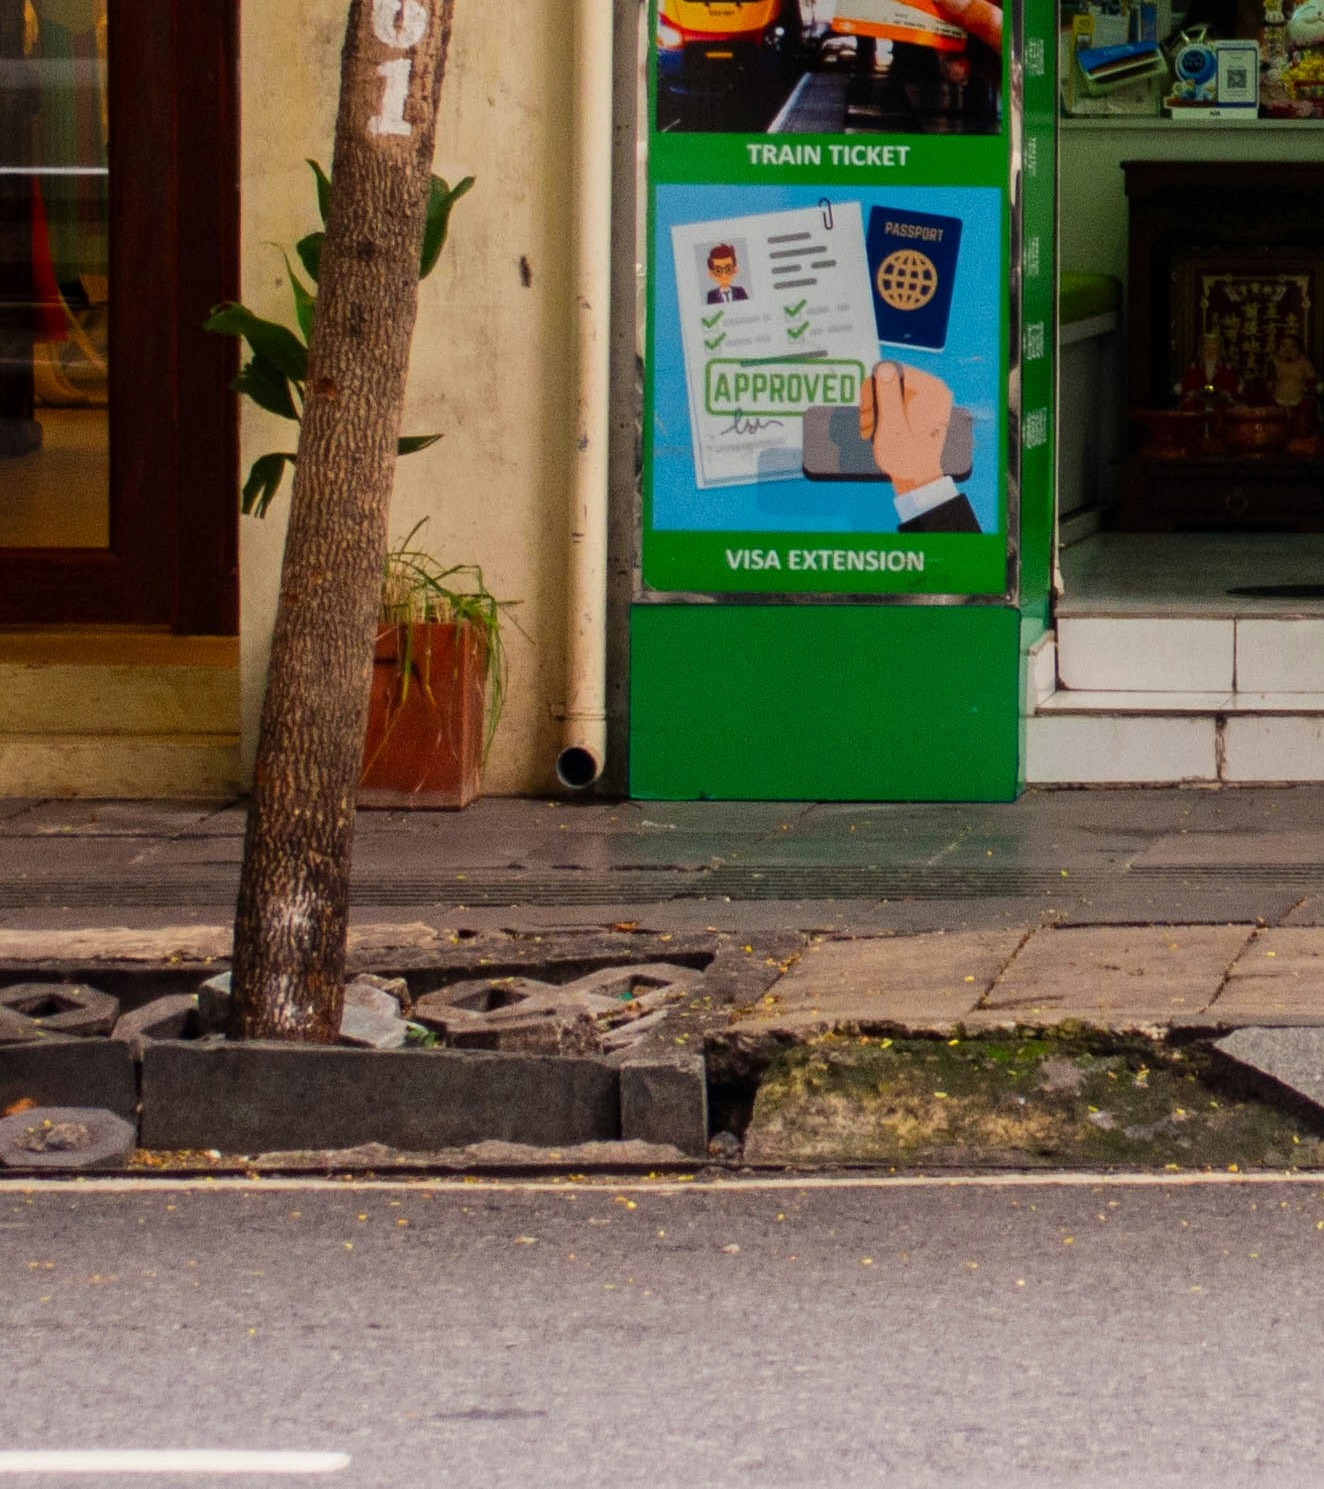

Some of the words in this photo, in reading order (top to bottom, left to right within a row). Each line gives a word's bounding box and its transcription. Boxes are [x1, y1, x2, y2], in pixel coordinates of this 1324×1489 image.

[747, 144, 822, 166] TRAIN
[829, 145, 910, 166] TICKET
[884, 222, 945, 242] PASSPORT
[714, 372, 856, 404] APPROVED
[726, 550, 781, 569] VISA
[789, 550, 924, 571] EXTENSION
